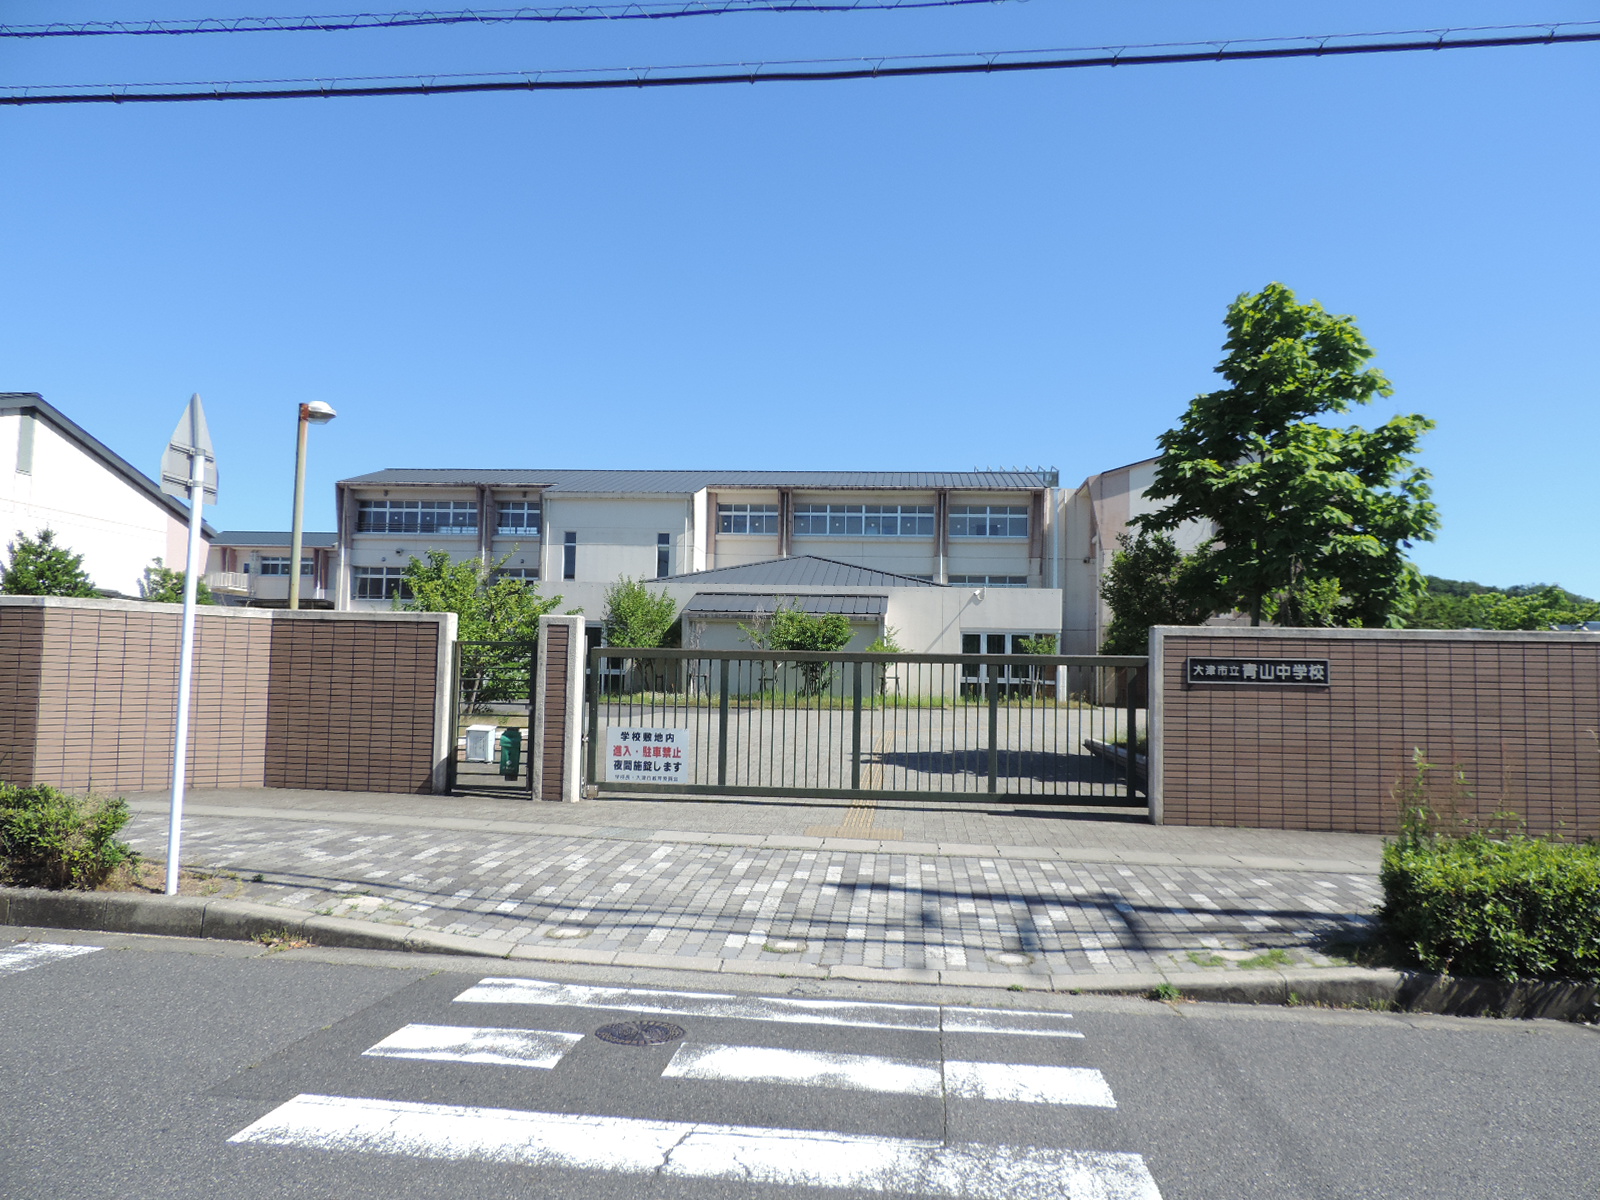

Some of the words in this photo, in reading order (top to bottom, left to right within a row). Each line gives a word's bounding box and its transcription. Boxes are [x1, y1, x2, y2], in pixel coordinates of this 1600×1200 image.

[1193, 663, 1325, 680] 大津市立青山中学校
[620, 731, 675, 743] 学校敷地内
[613, 745, 682, 759] 進入・駐車禁止
[613, 759, 682, 773] 夜間施錠します
